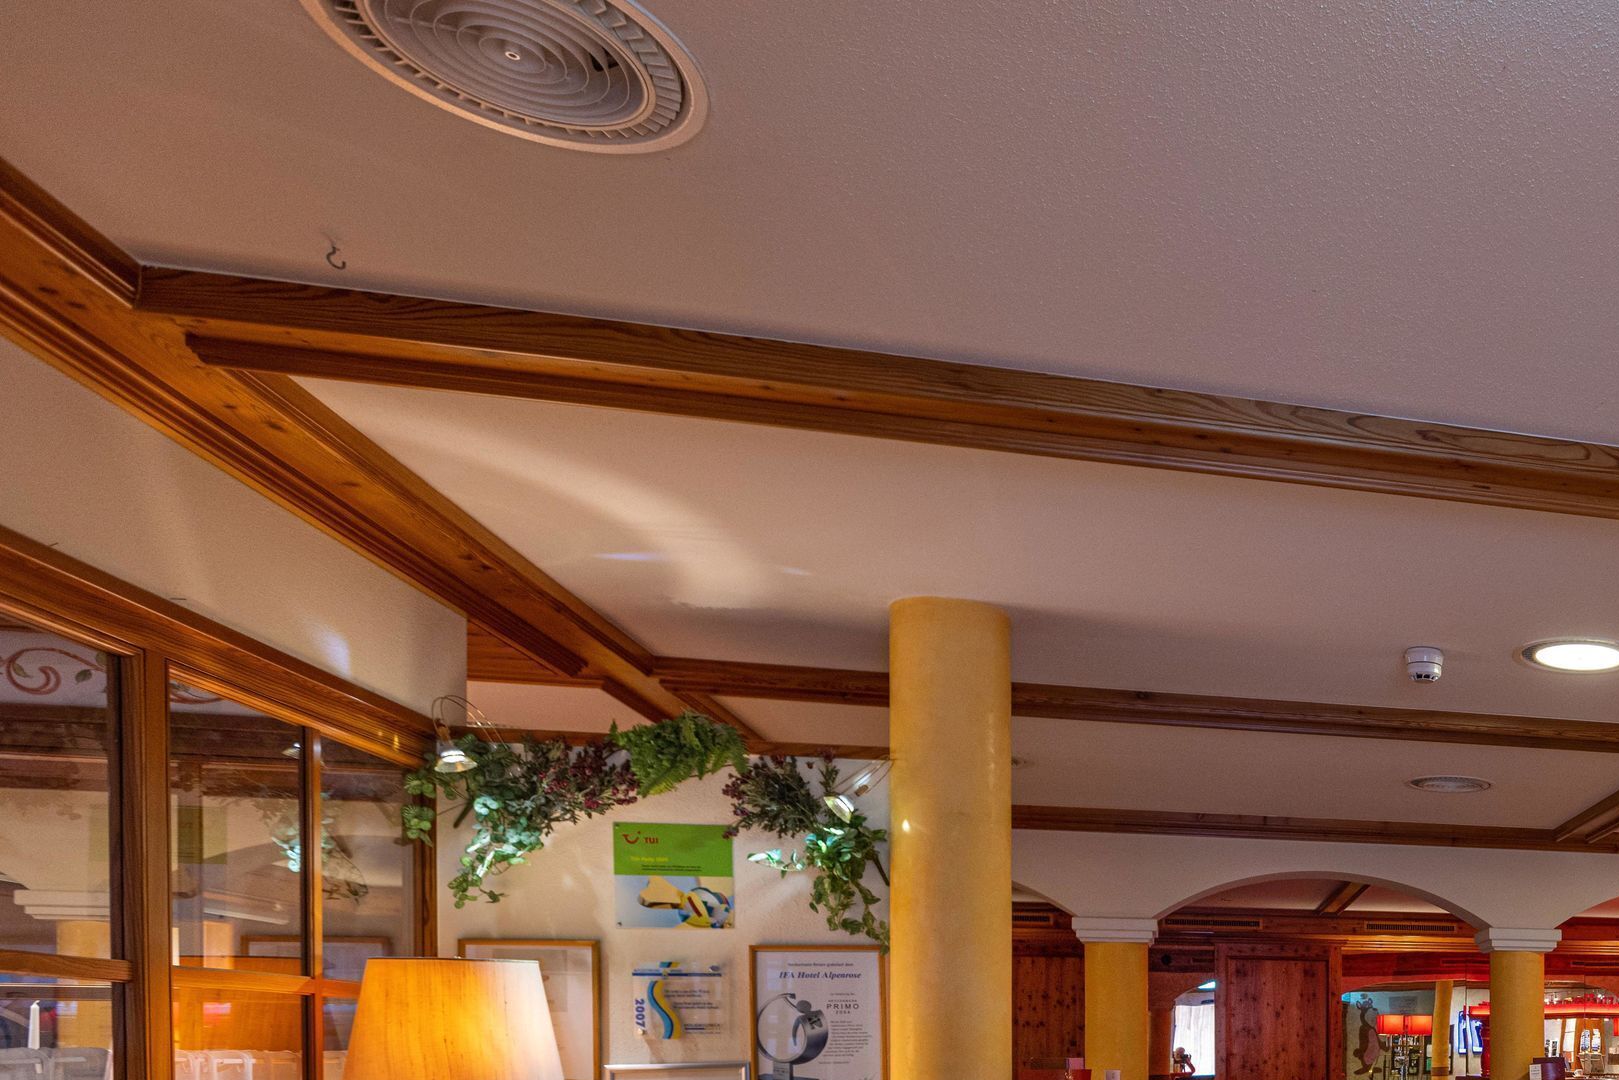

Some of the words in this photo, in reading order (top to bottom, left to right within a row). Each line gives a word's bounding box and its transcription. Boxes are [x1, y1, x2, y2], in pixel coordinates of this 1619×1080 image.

[779, 971, 795, 979] IFA
[797, 971, 820, 979] Hotel
[822, 971, 862, 980] Alpenrose
[635, 998, 646, 1028] 2007
